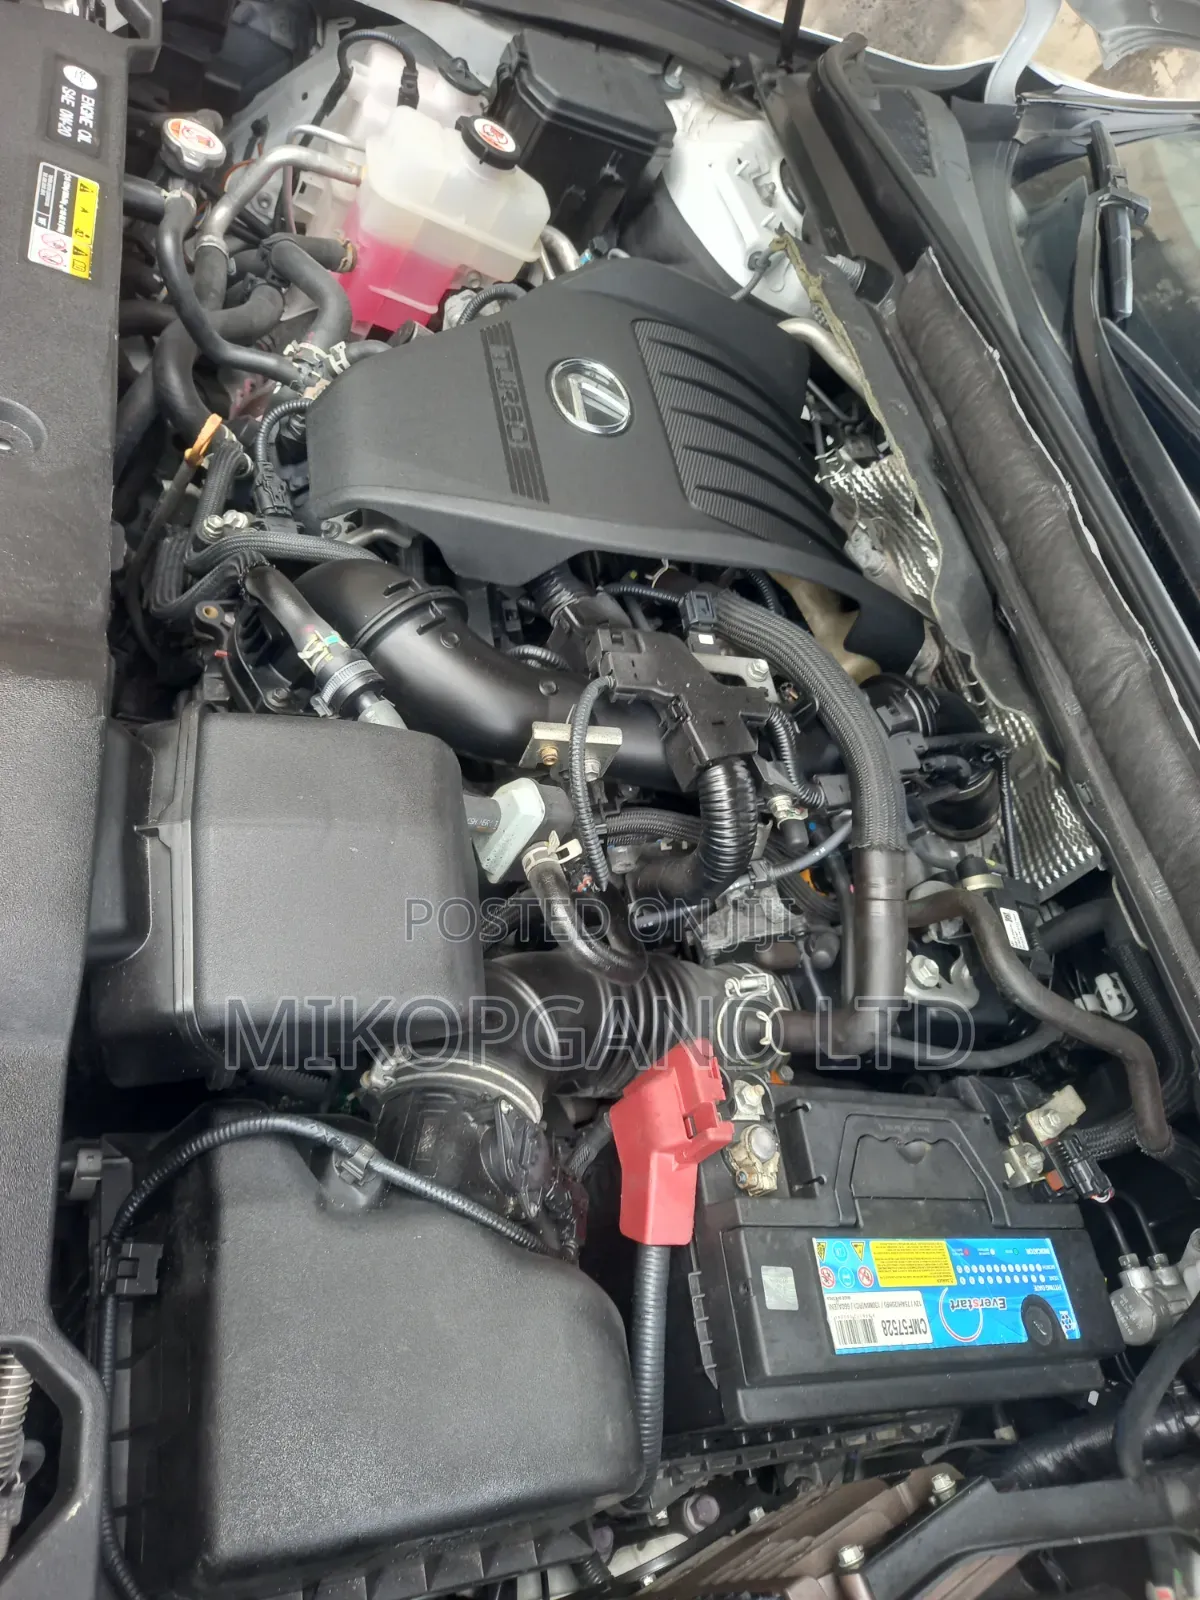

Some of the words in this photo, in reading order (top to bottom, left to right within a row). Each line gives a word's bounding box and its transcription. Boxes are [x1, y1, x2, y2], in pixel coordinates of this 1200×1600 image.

[61, 85, 76, 107] SAE
[57, 108, 74, 137] 0W-20
[79, 94, 95, 129] ENGINE
[77, 129, 92, 144] OIL
[491, 346, 530, 444] TURBO
[951, 1298, 1006, 1310] Everstart
[881, 1318, 928, 1337] CMF57528
